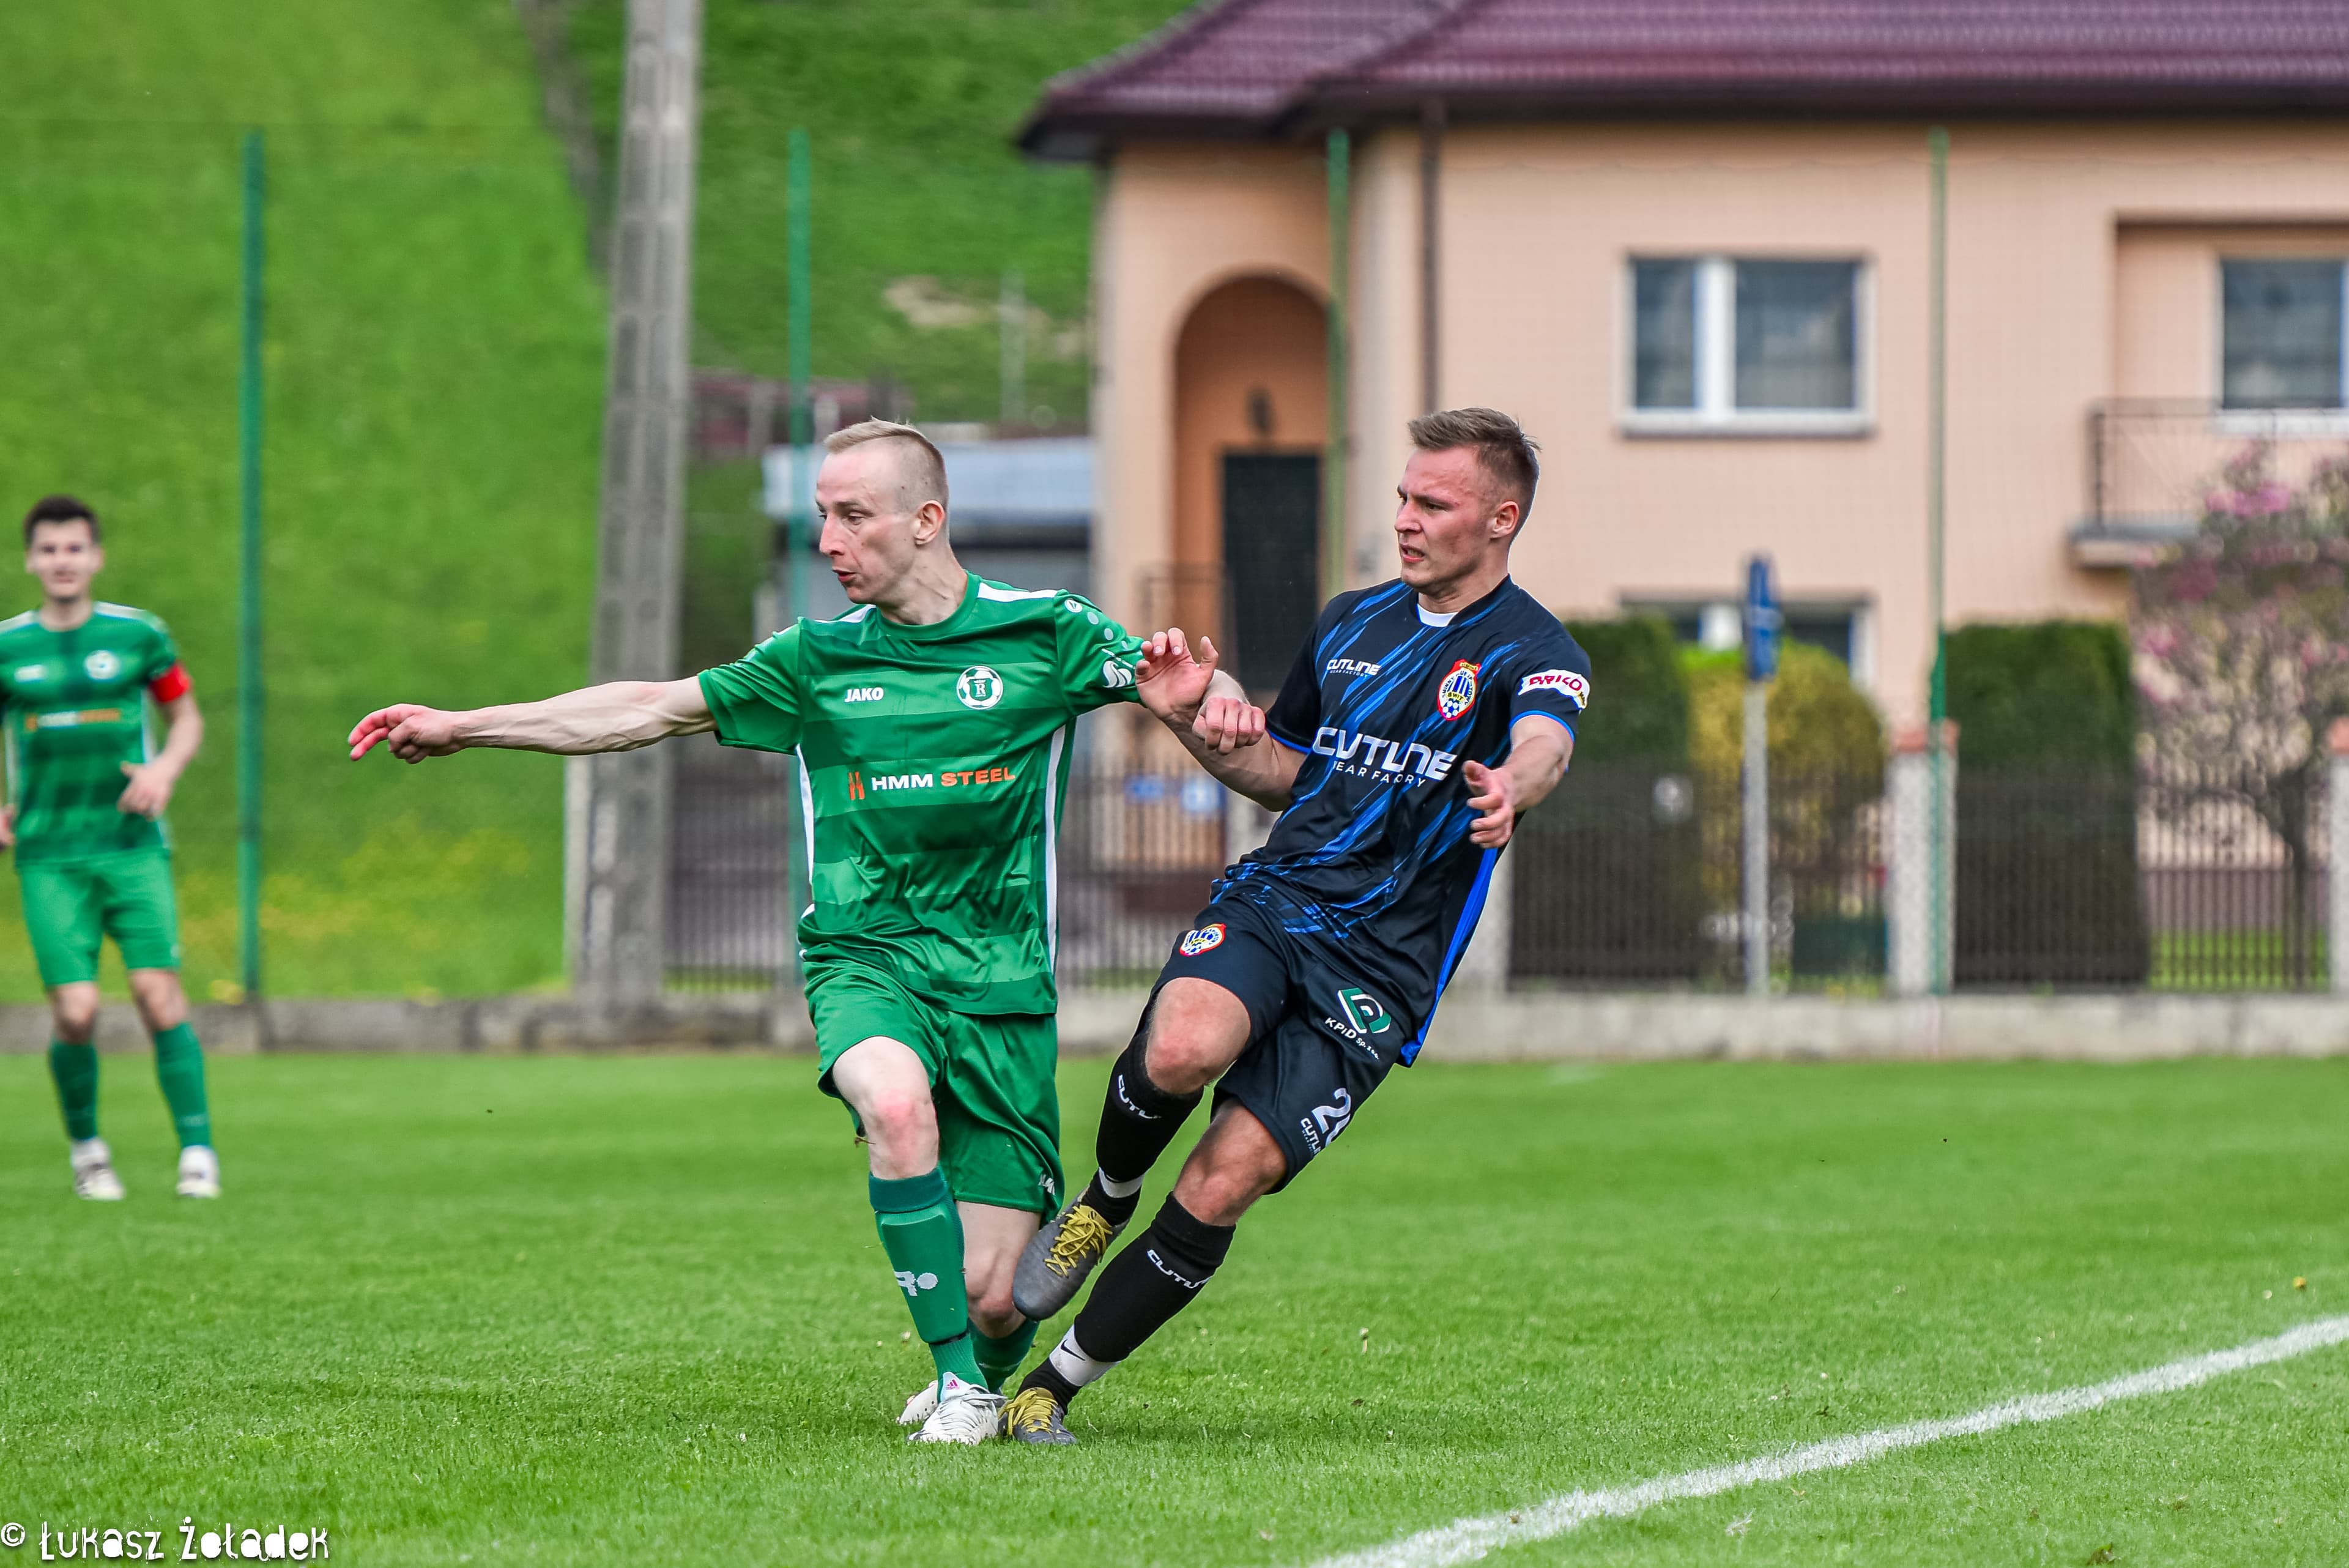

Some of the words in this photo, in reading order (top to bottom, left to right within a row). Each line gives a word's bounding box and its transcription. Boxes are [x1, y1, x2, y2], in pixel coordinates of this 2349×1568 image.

[1327, 659, 1381, 675] CUTLINE
[844, 687, 884, 703] JAKO
[1313, 726, 1458, 781] CUTLNE
[871, 773, 933, 791] HMM
[941, 767, 1015, 787] STEEL
